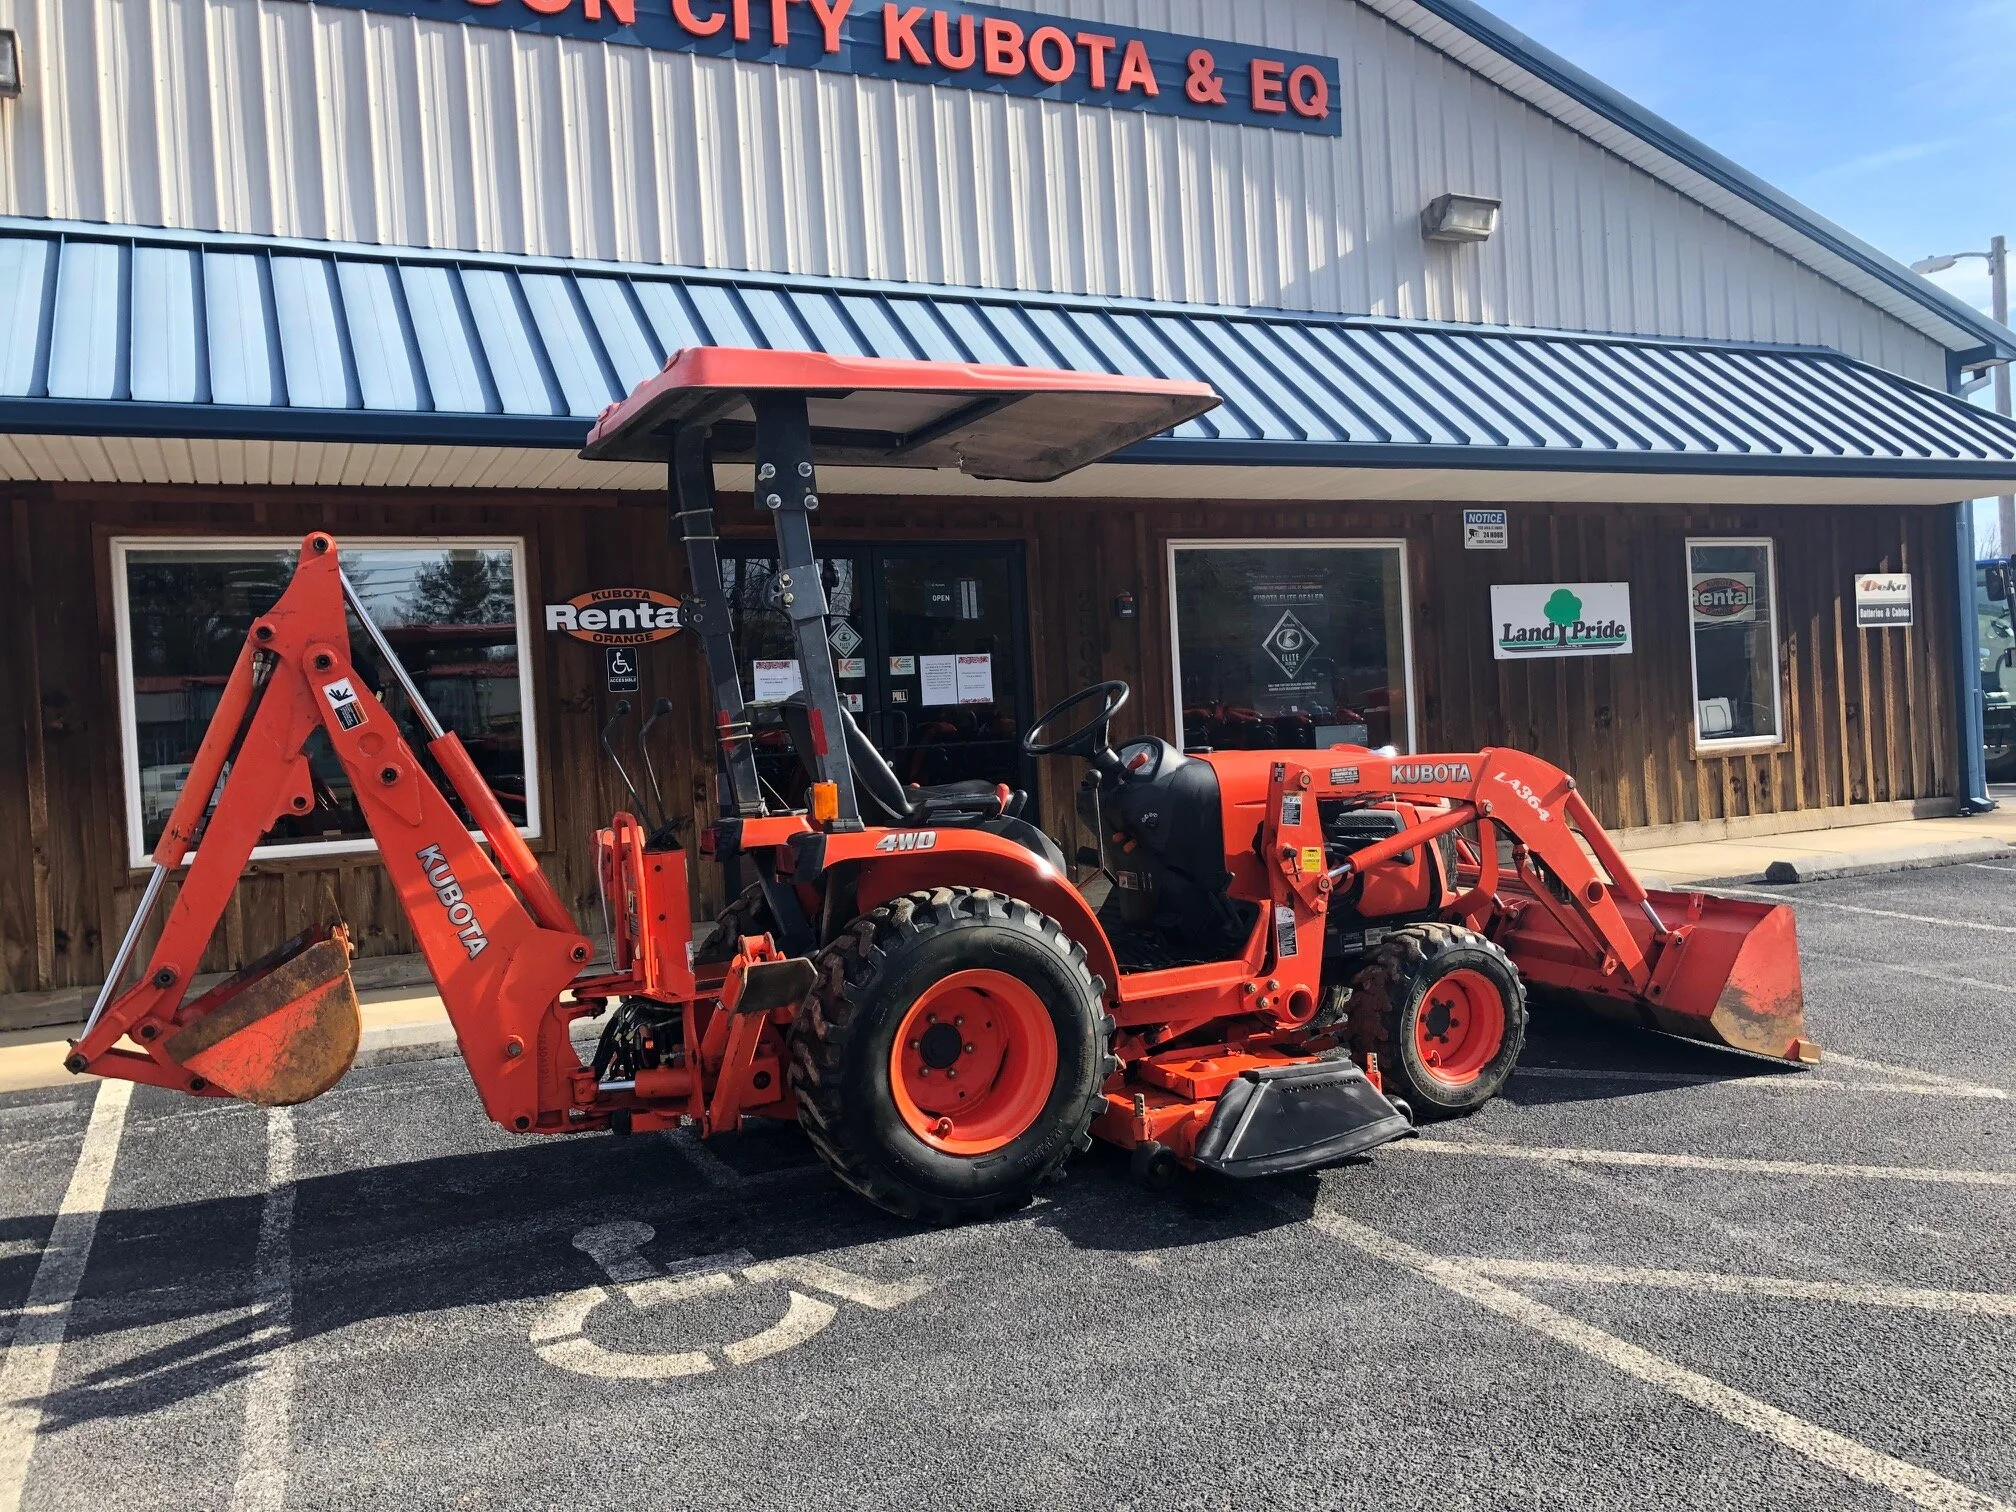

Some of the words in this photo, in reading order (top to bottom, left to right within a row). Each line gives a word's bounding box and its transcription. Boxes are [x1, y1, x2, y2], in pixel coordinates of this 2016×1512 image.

[672, 0, 851, 53] CITY
[884, 4, 1157, 96] KUBOTA
[1187, 50, 1227, 104] &
[1251, 59, 1329, 118] EQ
[1468, 513, 1503, 523] NOTICE
[591, 589, 650, 601] KUBOTA
[932, 594, 950, 602] OPEN
[545, 602, 683, 631] Renta
[592, 632, 654, 644] ORANGE
[1502, 622, 1555, 643] Land
[1572, 620, 1626, 640] Pride
[1281, 653, 1299, 662] ELITE
[892, 691, 907, 702] PULL
[1391, 763, 1472, 784] KUBOTA
[1493, 771, 1550, 822] LA364
[876, 831, 937, 853] 4WD
[416, 843, 489, 960] KUBOTA
